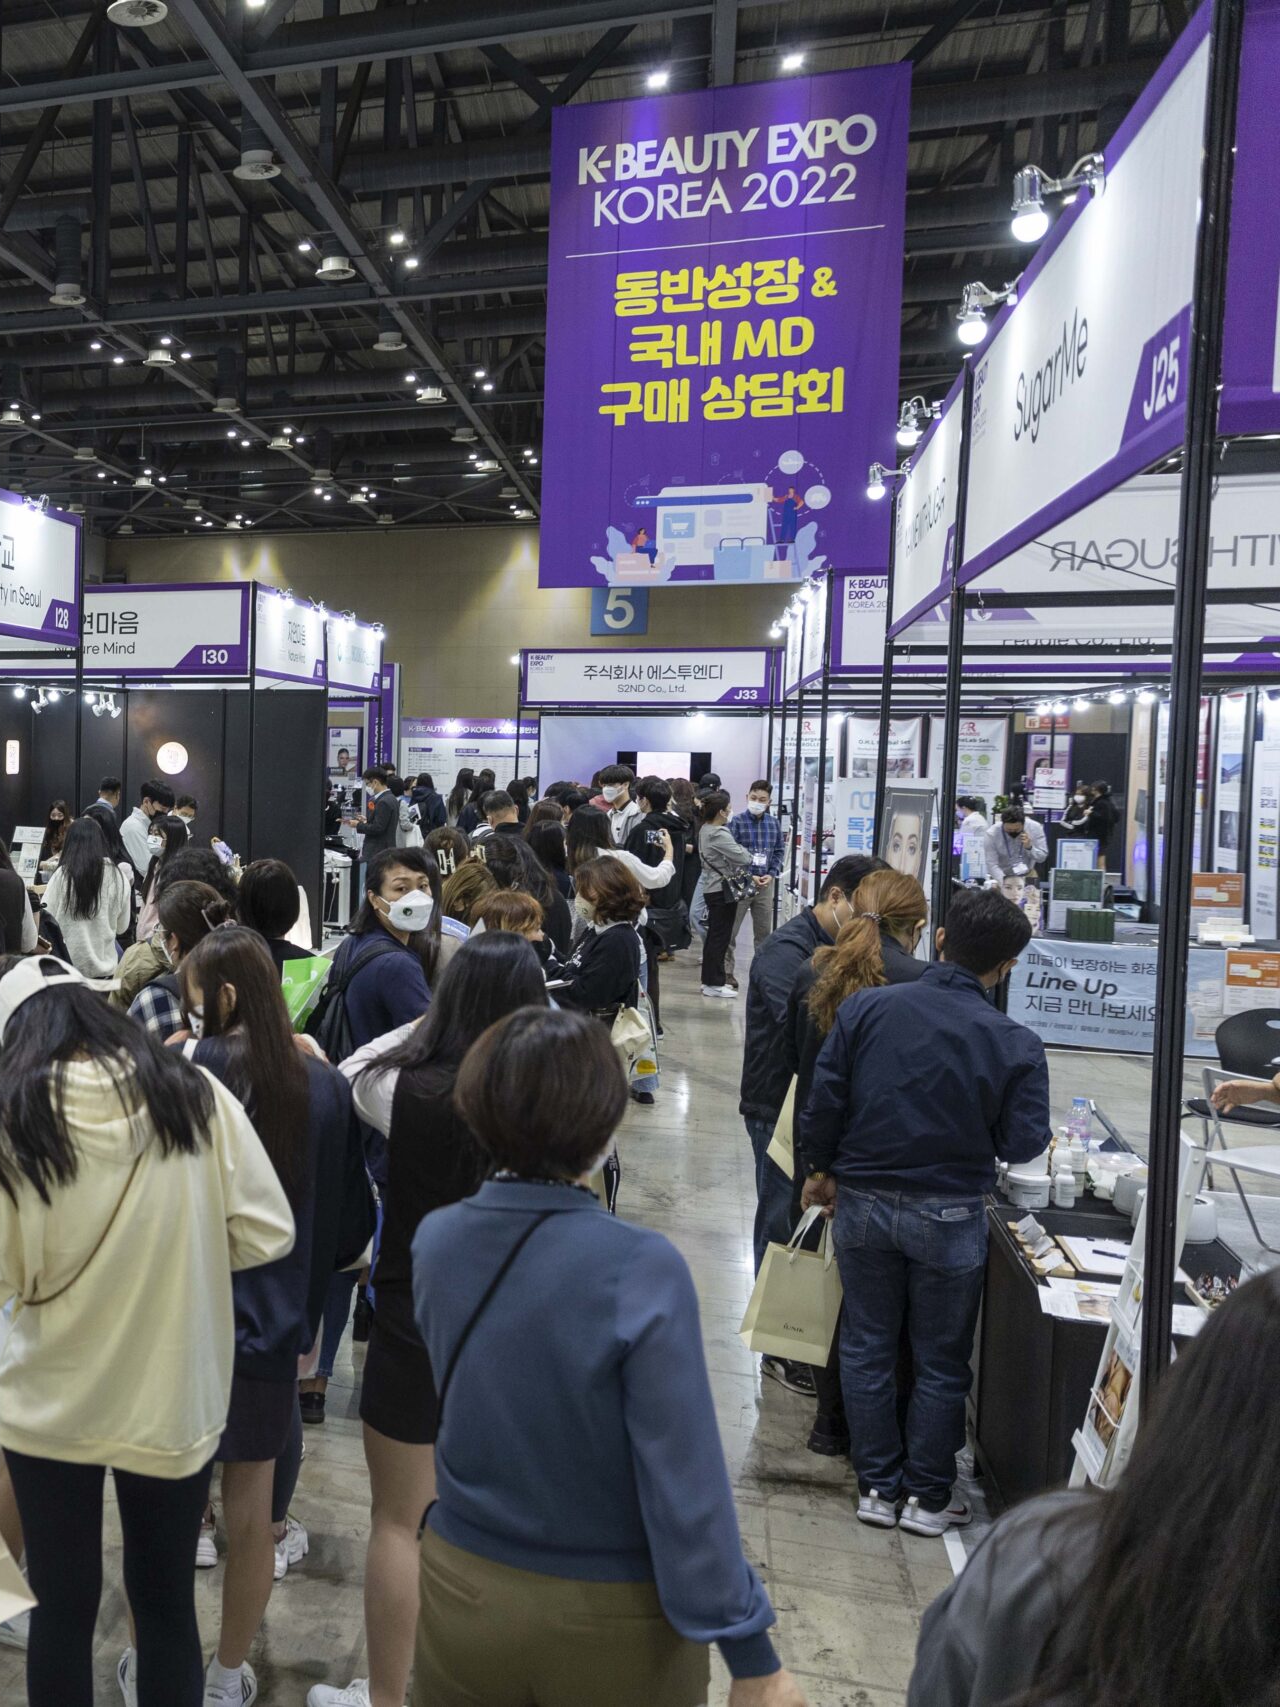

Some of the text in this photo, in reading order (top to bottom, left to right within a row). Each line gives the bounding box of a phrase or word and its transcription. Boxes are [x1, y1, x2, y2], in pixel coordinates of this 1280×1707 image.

[578, 114, 877, 185] K-BEAUTY EXPO
[593, 162, 857, 227] KOREA 2022
[614, 257, 838, 317] 동반성장 &
[629, 316, 815, 368] 국내 MD
[1014, 306, 1088, 444] SugarMe
[1143, 336, 1180, 421] J25
[599, 367, 845, 426] 구매 상담회
[9, 582, 18, 604] in
[19, 586, 42, 608] Seoul
[849, 579, 888, 589] K-BEAUT
[849, 590, 874, 600] EXPO
[604, 587, 635, 629] 5
[848, 601, 875, 609] KOREA
[103, 642, 135, 655] Mind
[583, 664, 723, 681] 주식회사 에스투엔디
[617, 685, 687, 694] S2ND Co., Ltd.
[734, 690, 758, 700] J33
[1071, 958, 1128, 974] 보장하는
[1026, 972, 1118, 999] Line Up
[1025, 994, 1062, 1014] 지금
